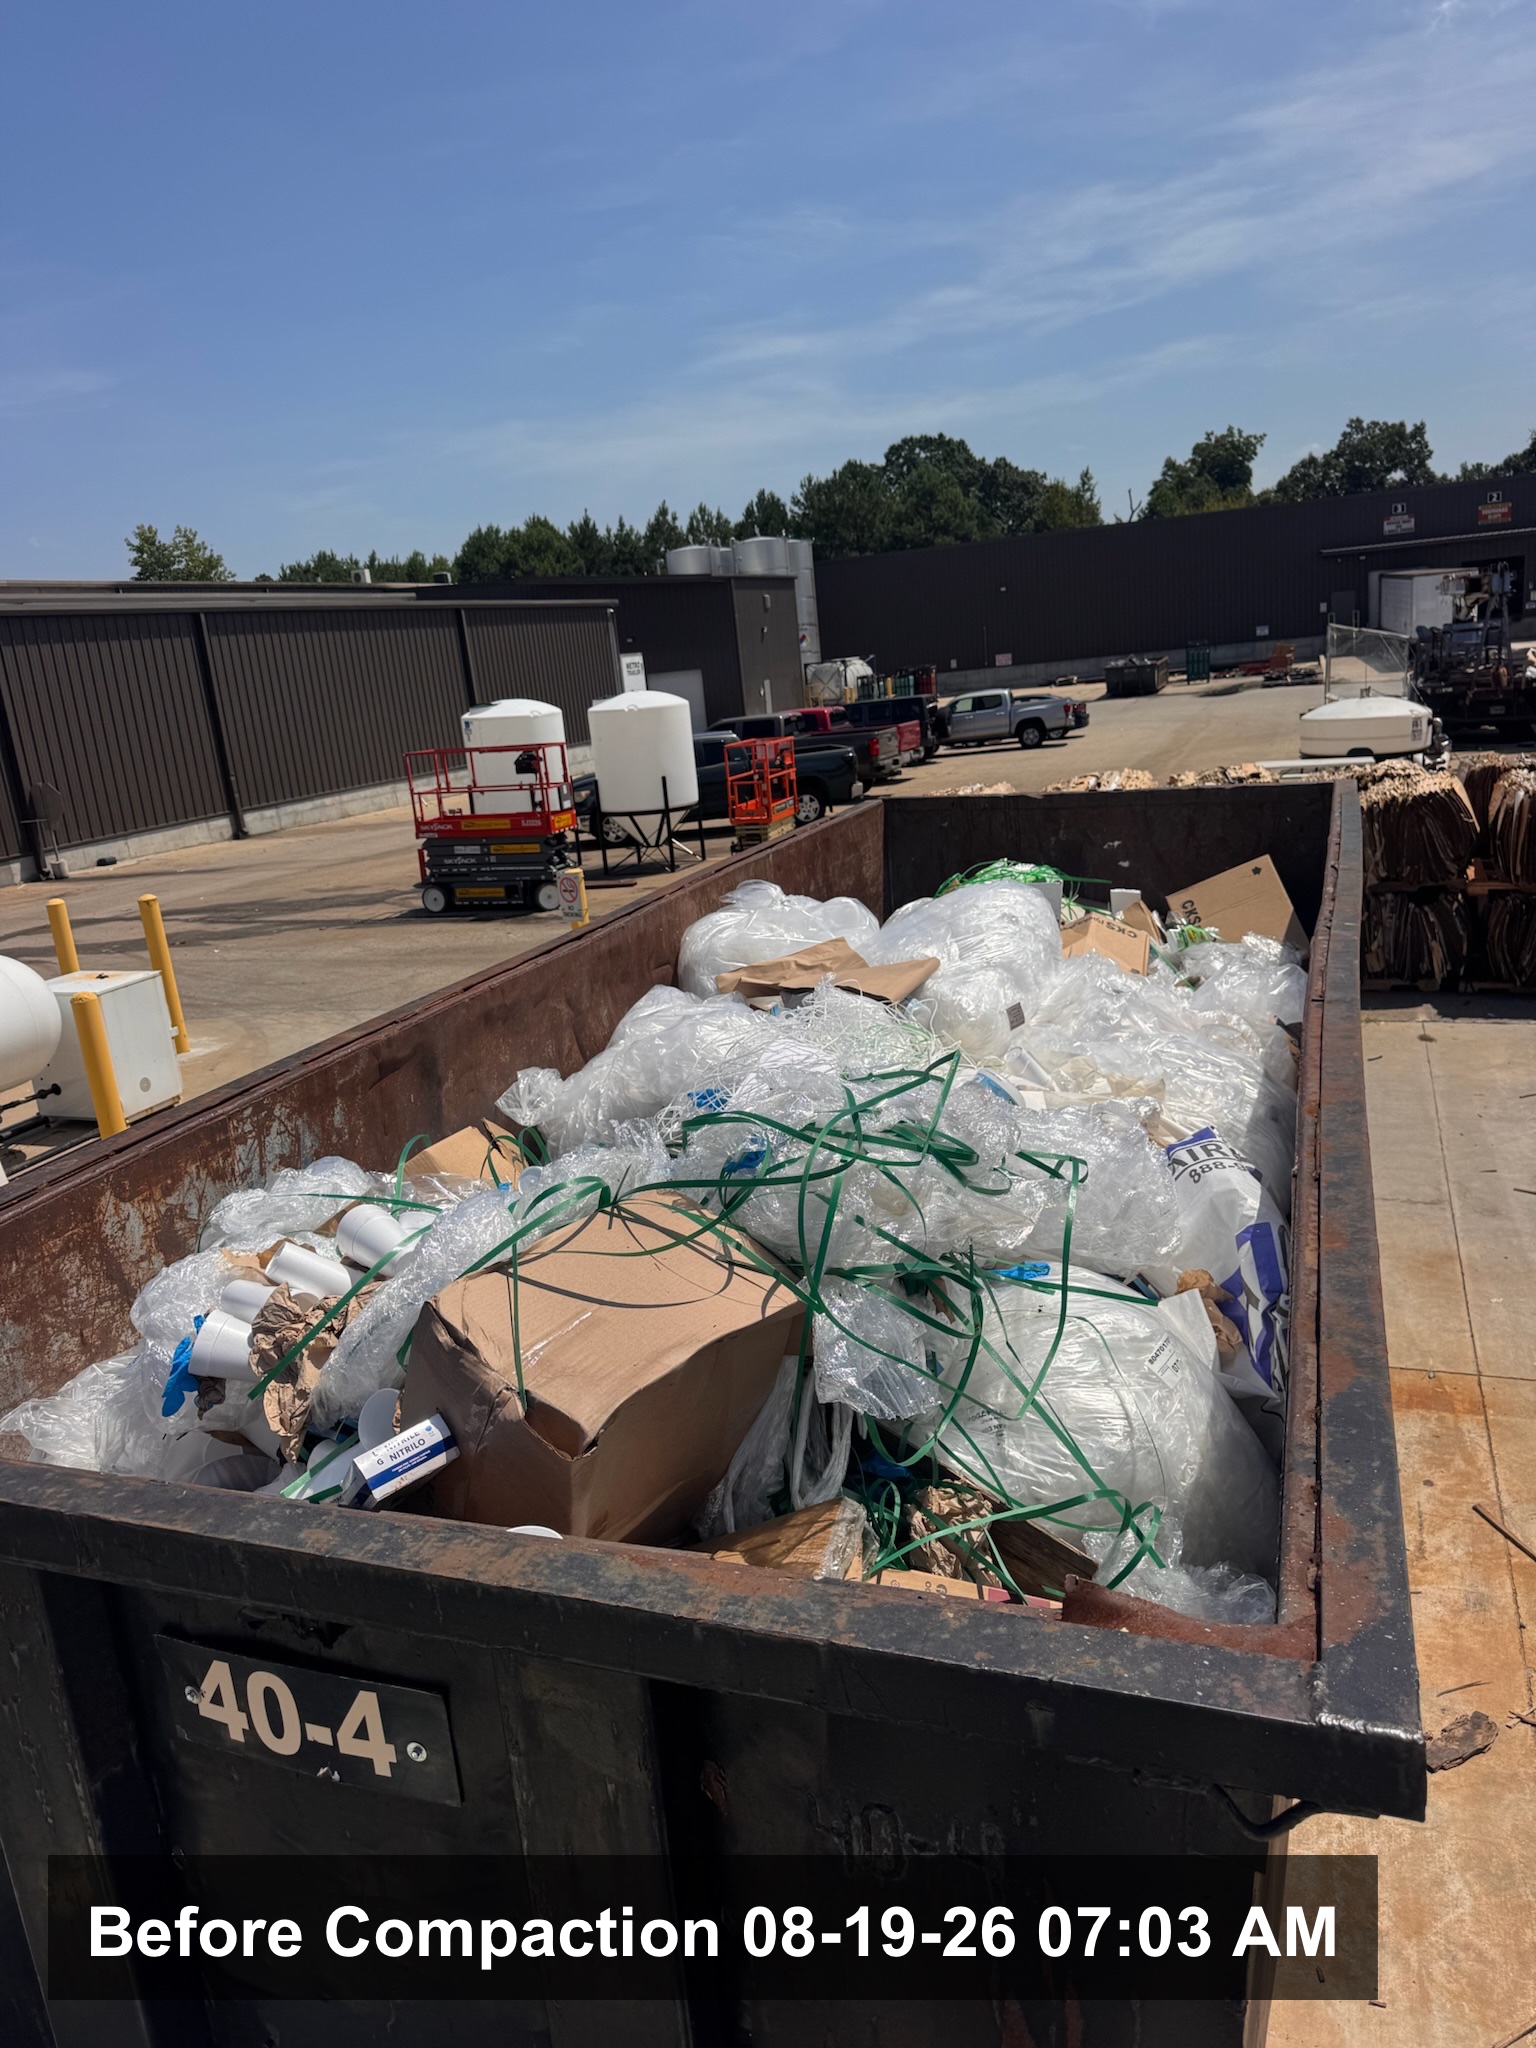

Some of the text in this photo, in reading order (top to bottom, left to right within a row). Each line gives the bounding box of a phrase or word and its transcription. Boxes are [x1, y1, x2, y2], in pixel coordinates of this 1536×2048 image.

[420, 822, 453, 831] SKYJACK
[443, 856, 477, 865] SKYJACK
[1106, 921, 1138, 939] CKS
[376, 1458, 385, 1467] G
[389, 1438, 426, 1462] NITRILO
[198, 1661, 396, 1778] 40-4
